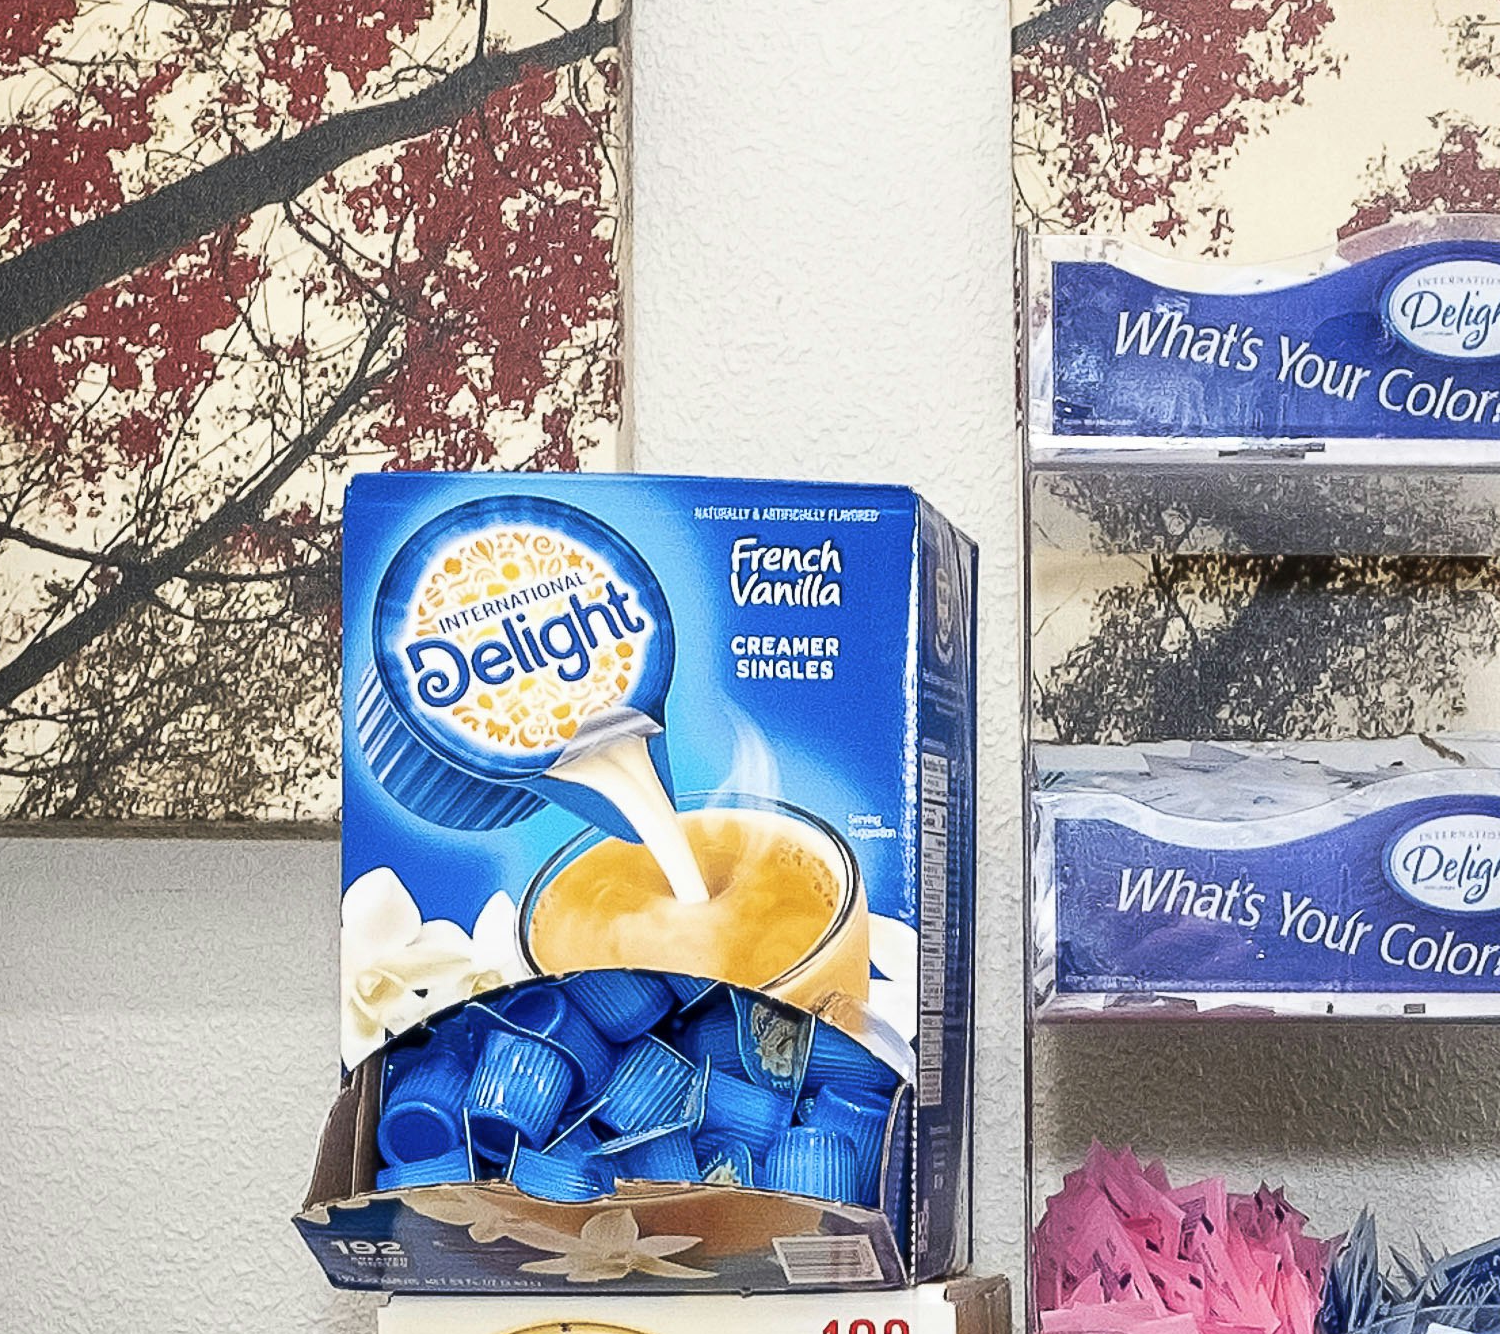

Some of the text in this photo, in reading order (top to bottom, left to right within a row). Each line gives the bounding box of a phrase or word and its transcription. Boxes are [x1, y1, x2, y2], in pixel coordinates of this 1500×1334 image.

[1114, 310, 1263, 370] What's
[1277, 336, 1371, 403] Your
[731, 537, 842, 574] French
[438, 572, 586, 634] INTERNATIONAL
[730, 572, 842, 607] Vanilla
[406, 581, 645, 708] Delight
[730, 635, 840, 657] CREAMER
[736, 659, 834, 680] SINGLES
[1117, 867, 1266, 927] What's
[1278, 892, 1373, 957] Your
[330, 1240, 405, 1255] 192
